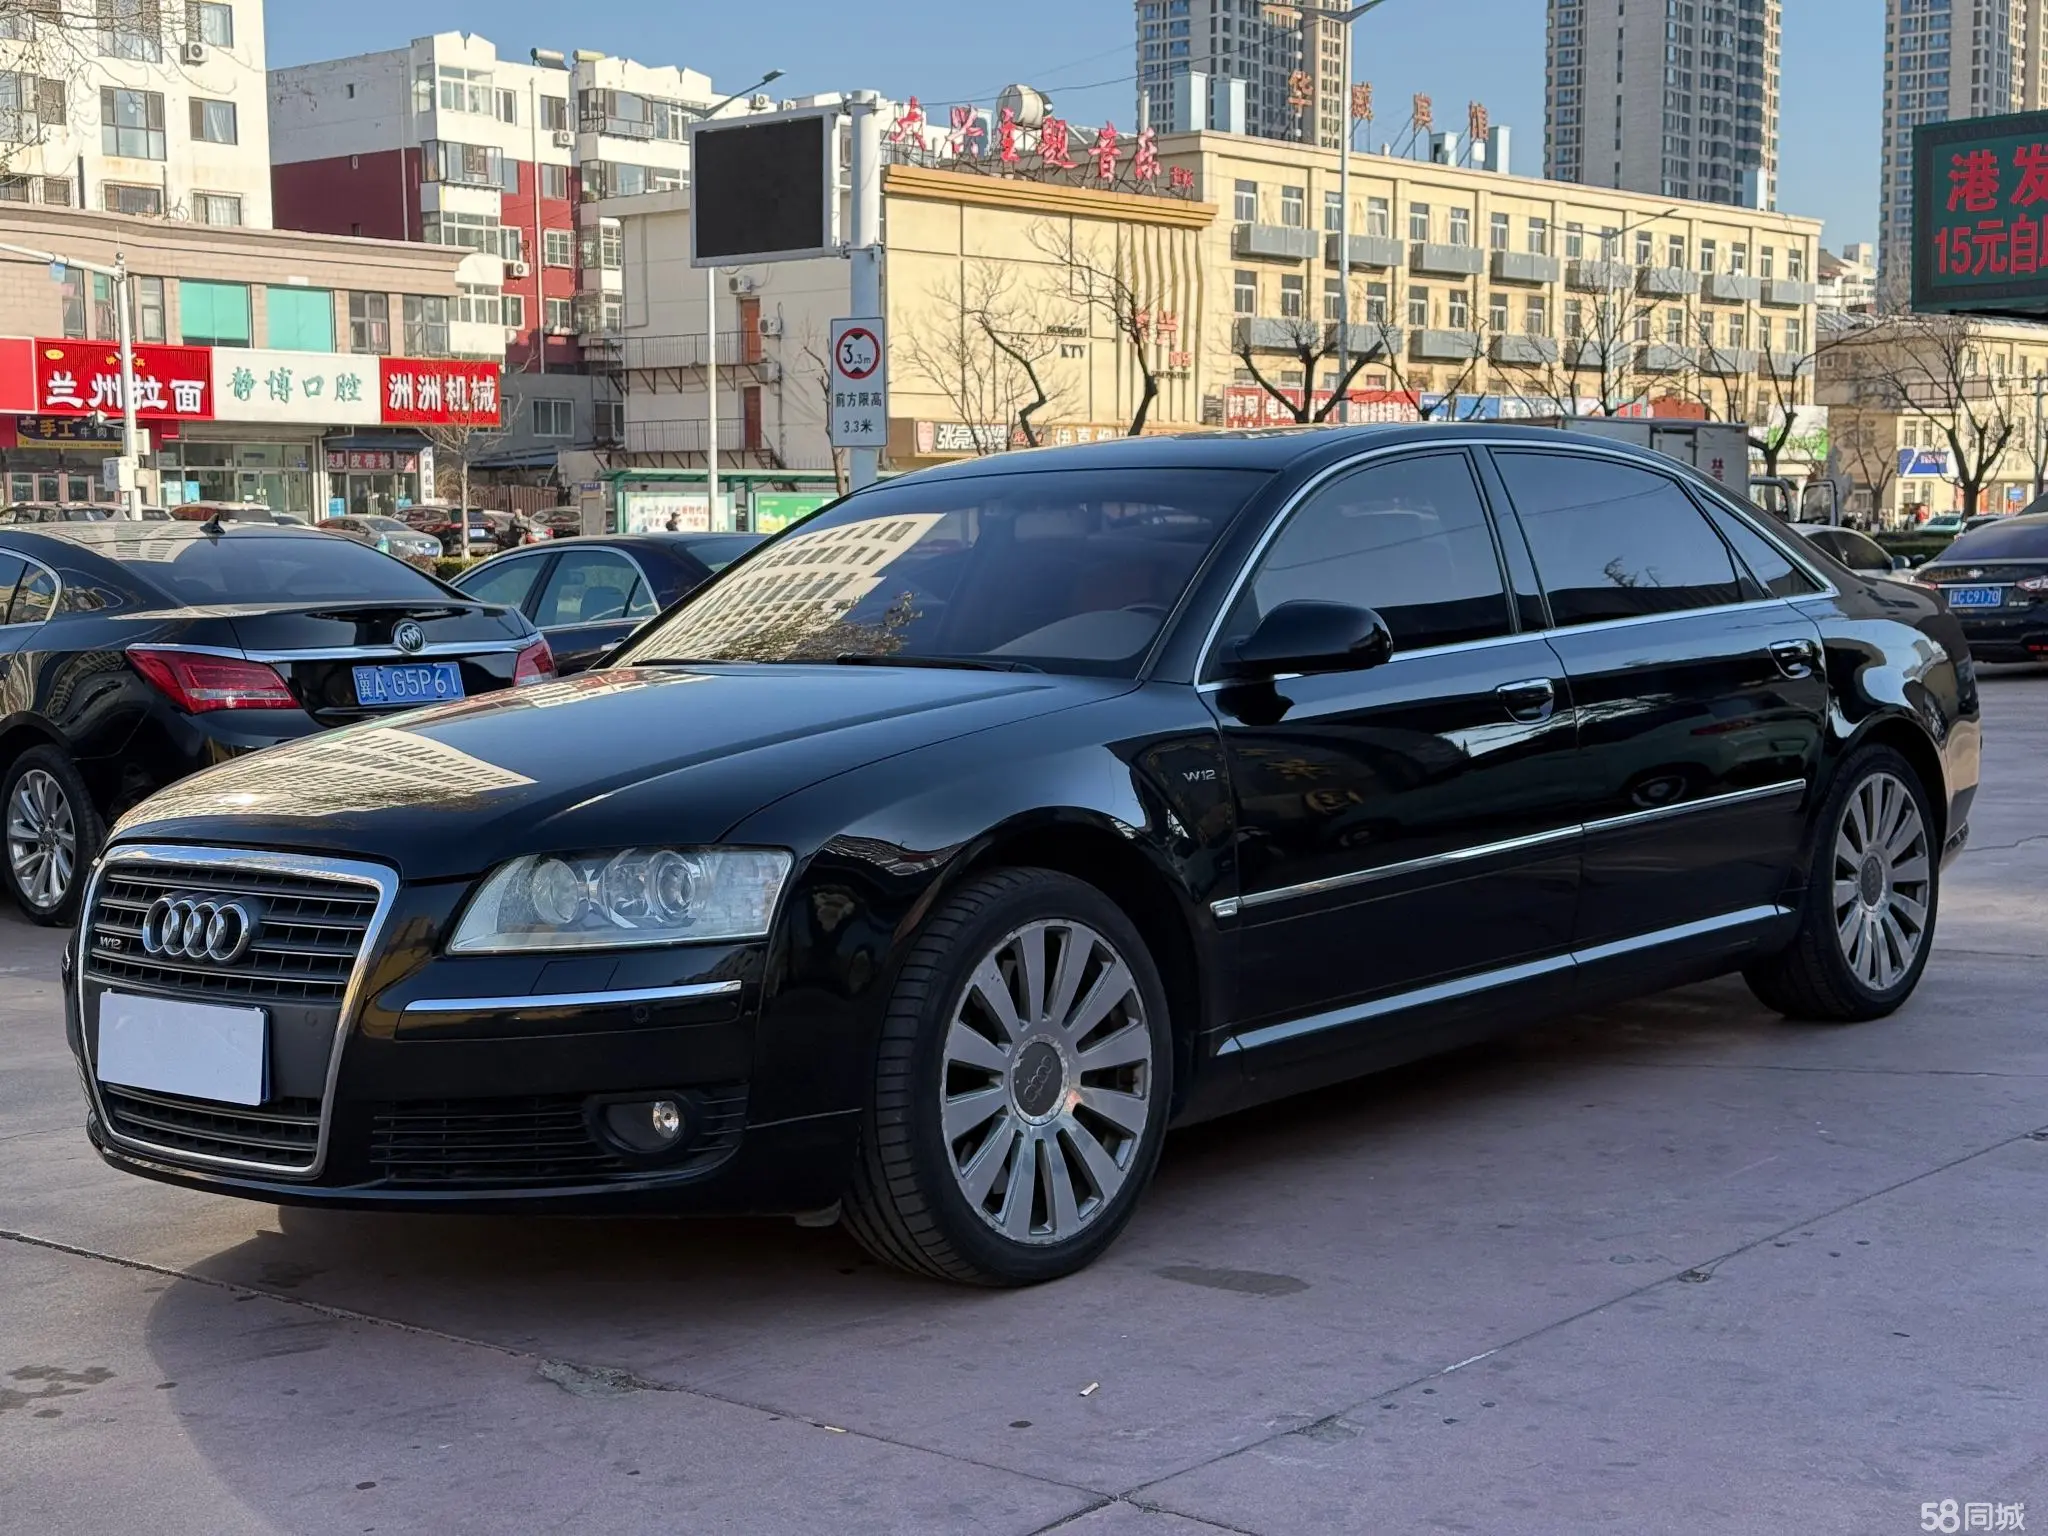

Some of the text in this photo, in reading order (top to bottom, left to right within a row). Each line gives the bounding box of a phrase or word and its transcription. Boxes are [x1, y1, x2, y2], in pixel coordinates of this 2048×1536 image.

[1946, 144, 2048, 212] 港发
[843, 343, 872, 365] 3.3m
[1060, 343, 1086, 358] KTV
[46, 370, 205, 414] 兰州拉面
[227, 365, 363, 404] 静博口腔
[388, 373, 497, 413] 洲洲机械
[835, 391, 882, 408] 前方限高
[843, 418, 874, 434] 3.3米
[1182, 769, 1216, 782] W12
[99, 935, 122, 950] W12
